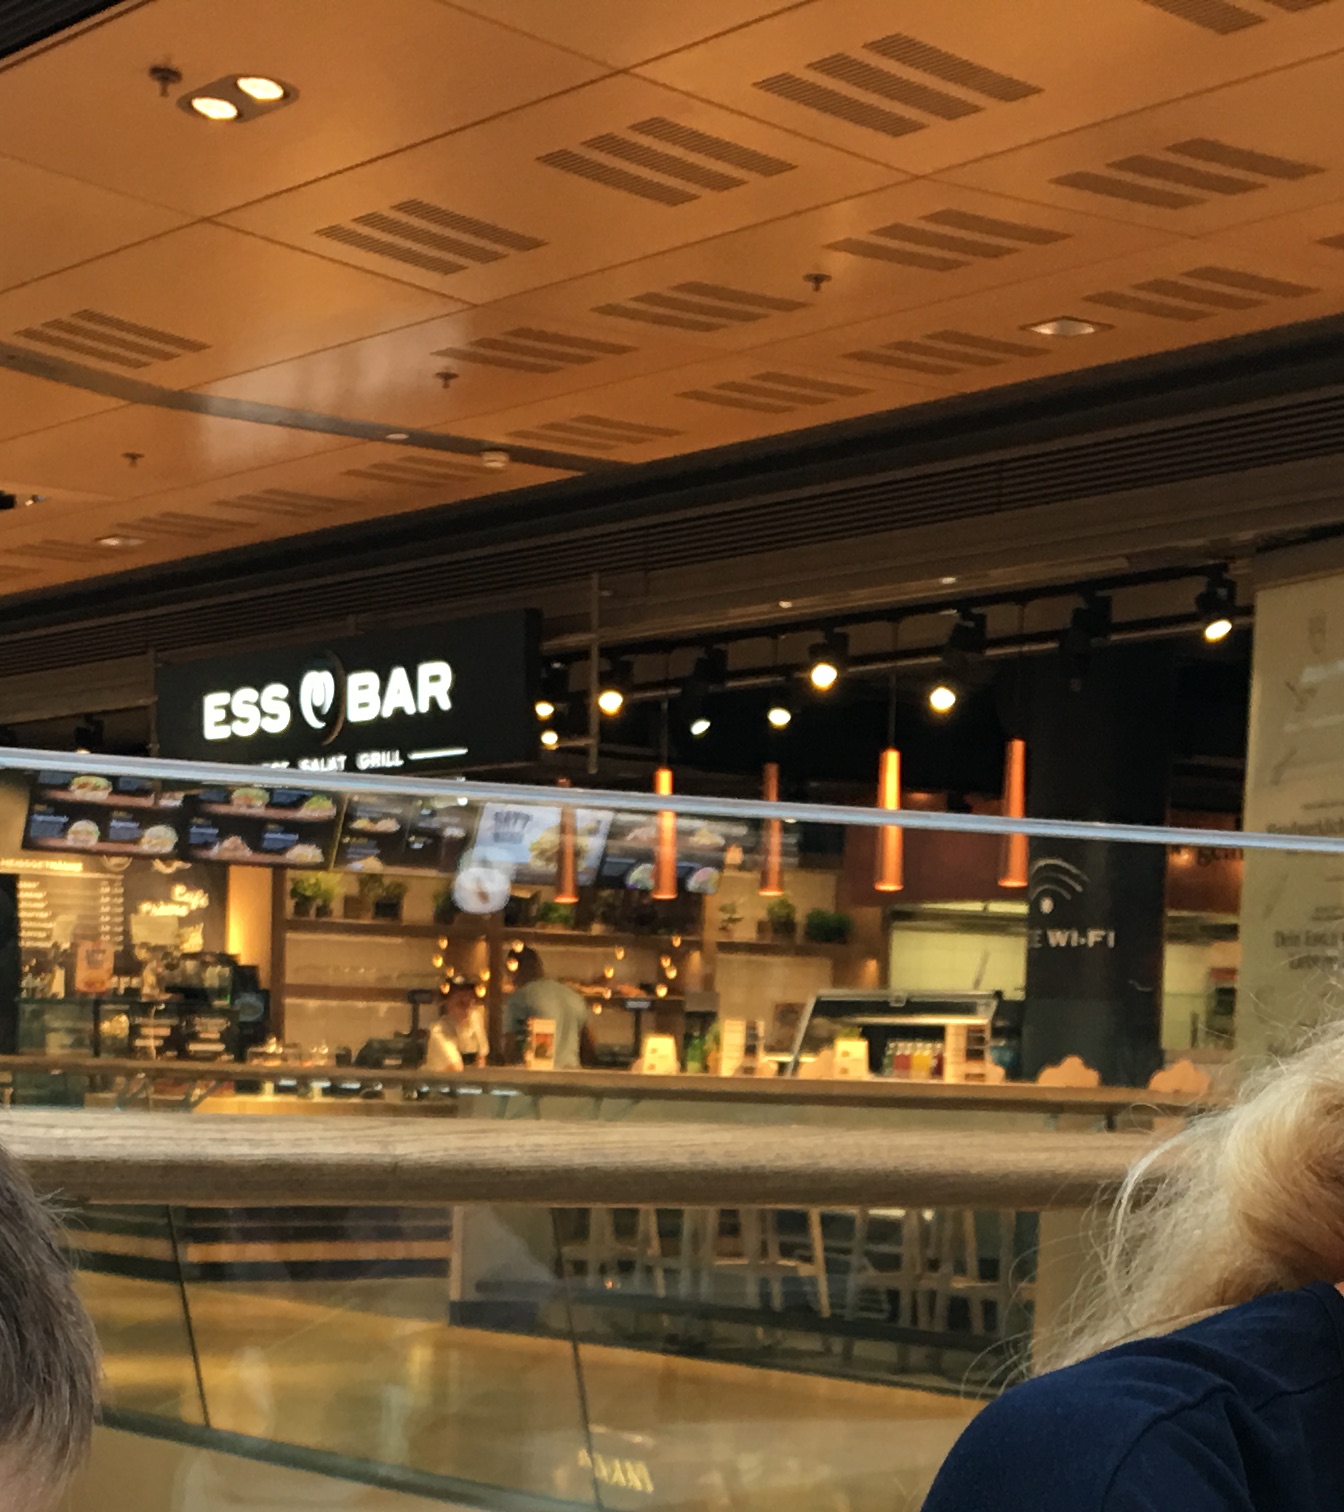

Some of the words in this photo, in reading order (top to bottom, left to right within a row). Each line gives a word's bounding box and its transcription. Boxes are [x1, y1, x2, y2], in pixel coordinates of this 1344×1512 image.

[203, 682, 292, 740] ESS
[346, 660, 453, 724] BAR
[297, 754, 348, 772] SALAT
[356, 750, 404, 771] GRILL
